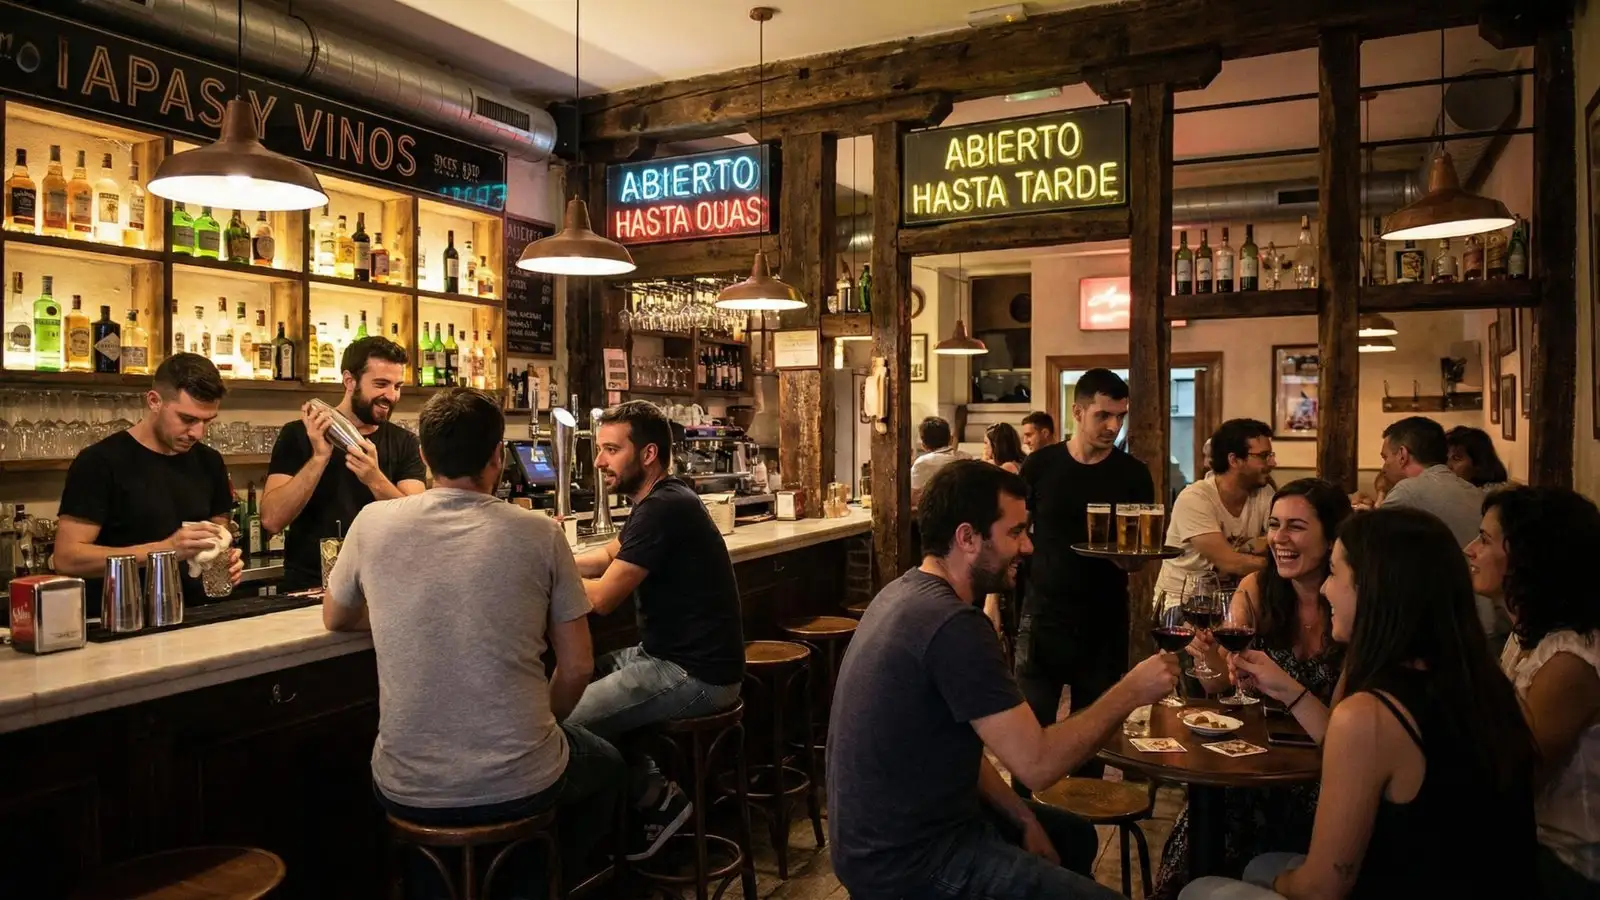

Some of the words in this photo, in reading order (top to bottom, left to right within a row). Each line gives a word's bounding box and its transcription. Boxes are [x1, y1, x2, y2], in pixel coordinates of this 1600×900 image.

[247, 89, 278, 140] Y
[295, 102, 417, 177] VINOS
[944, 121, 1080, 171] ABIERTO
[620, 155, 755, 203] ABIERTO
[912, 174, 1007, 215] HASTA
[1014, 161, 1119, 204] TARDE
[615, 204, 690, 239] HASTA
